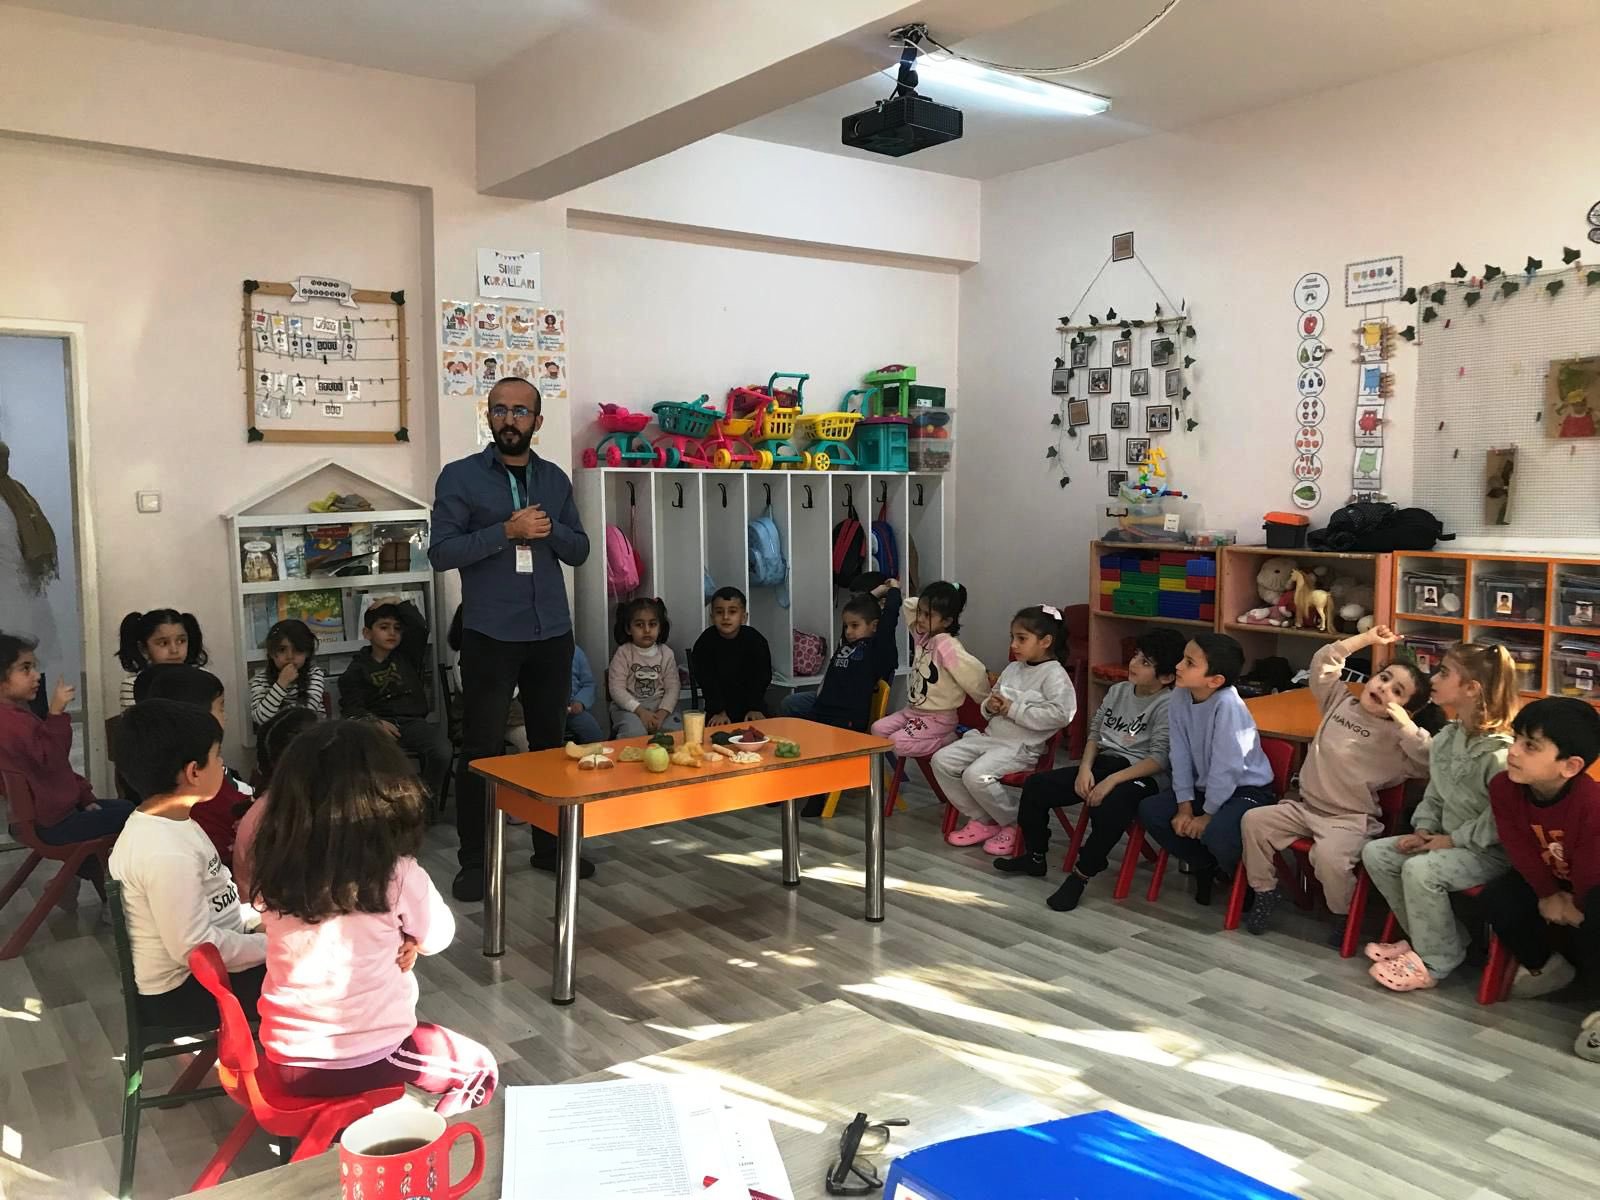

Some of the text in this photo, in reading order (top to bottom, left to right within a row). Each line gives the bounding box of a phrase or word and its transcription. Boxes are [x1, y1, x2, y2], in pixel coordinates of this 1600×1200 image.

[498, 263, 522, 275] SINIF
[483, 275, 535, 289] KURALLARI
[1331, 714, 1370, 738] MANGO
